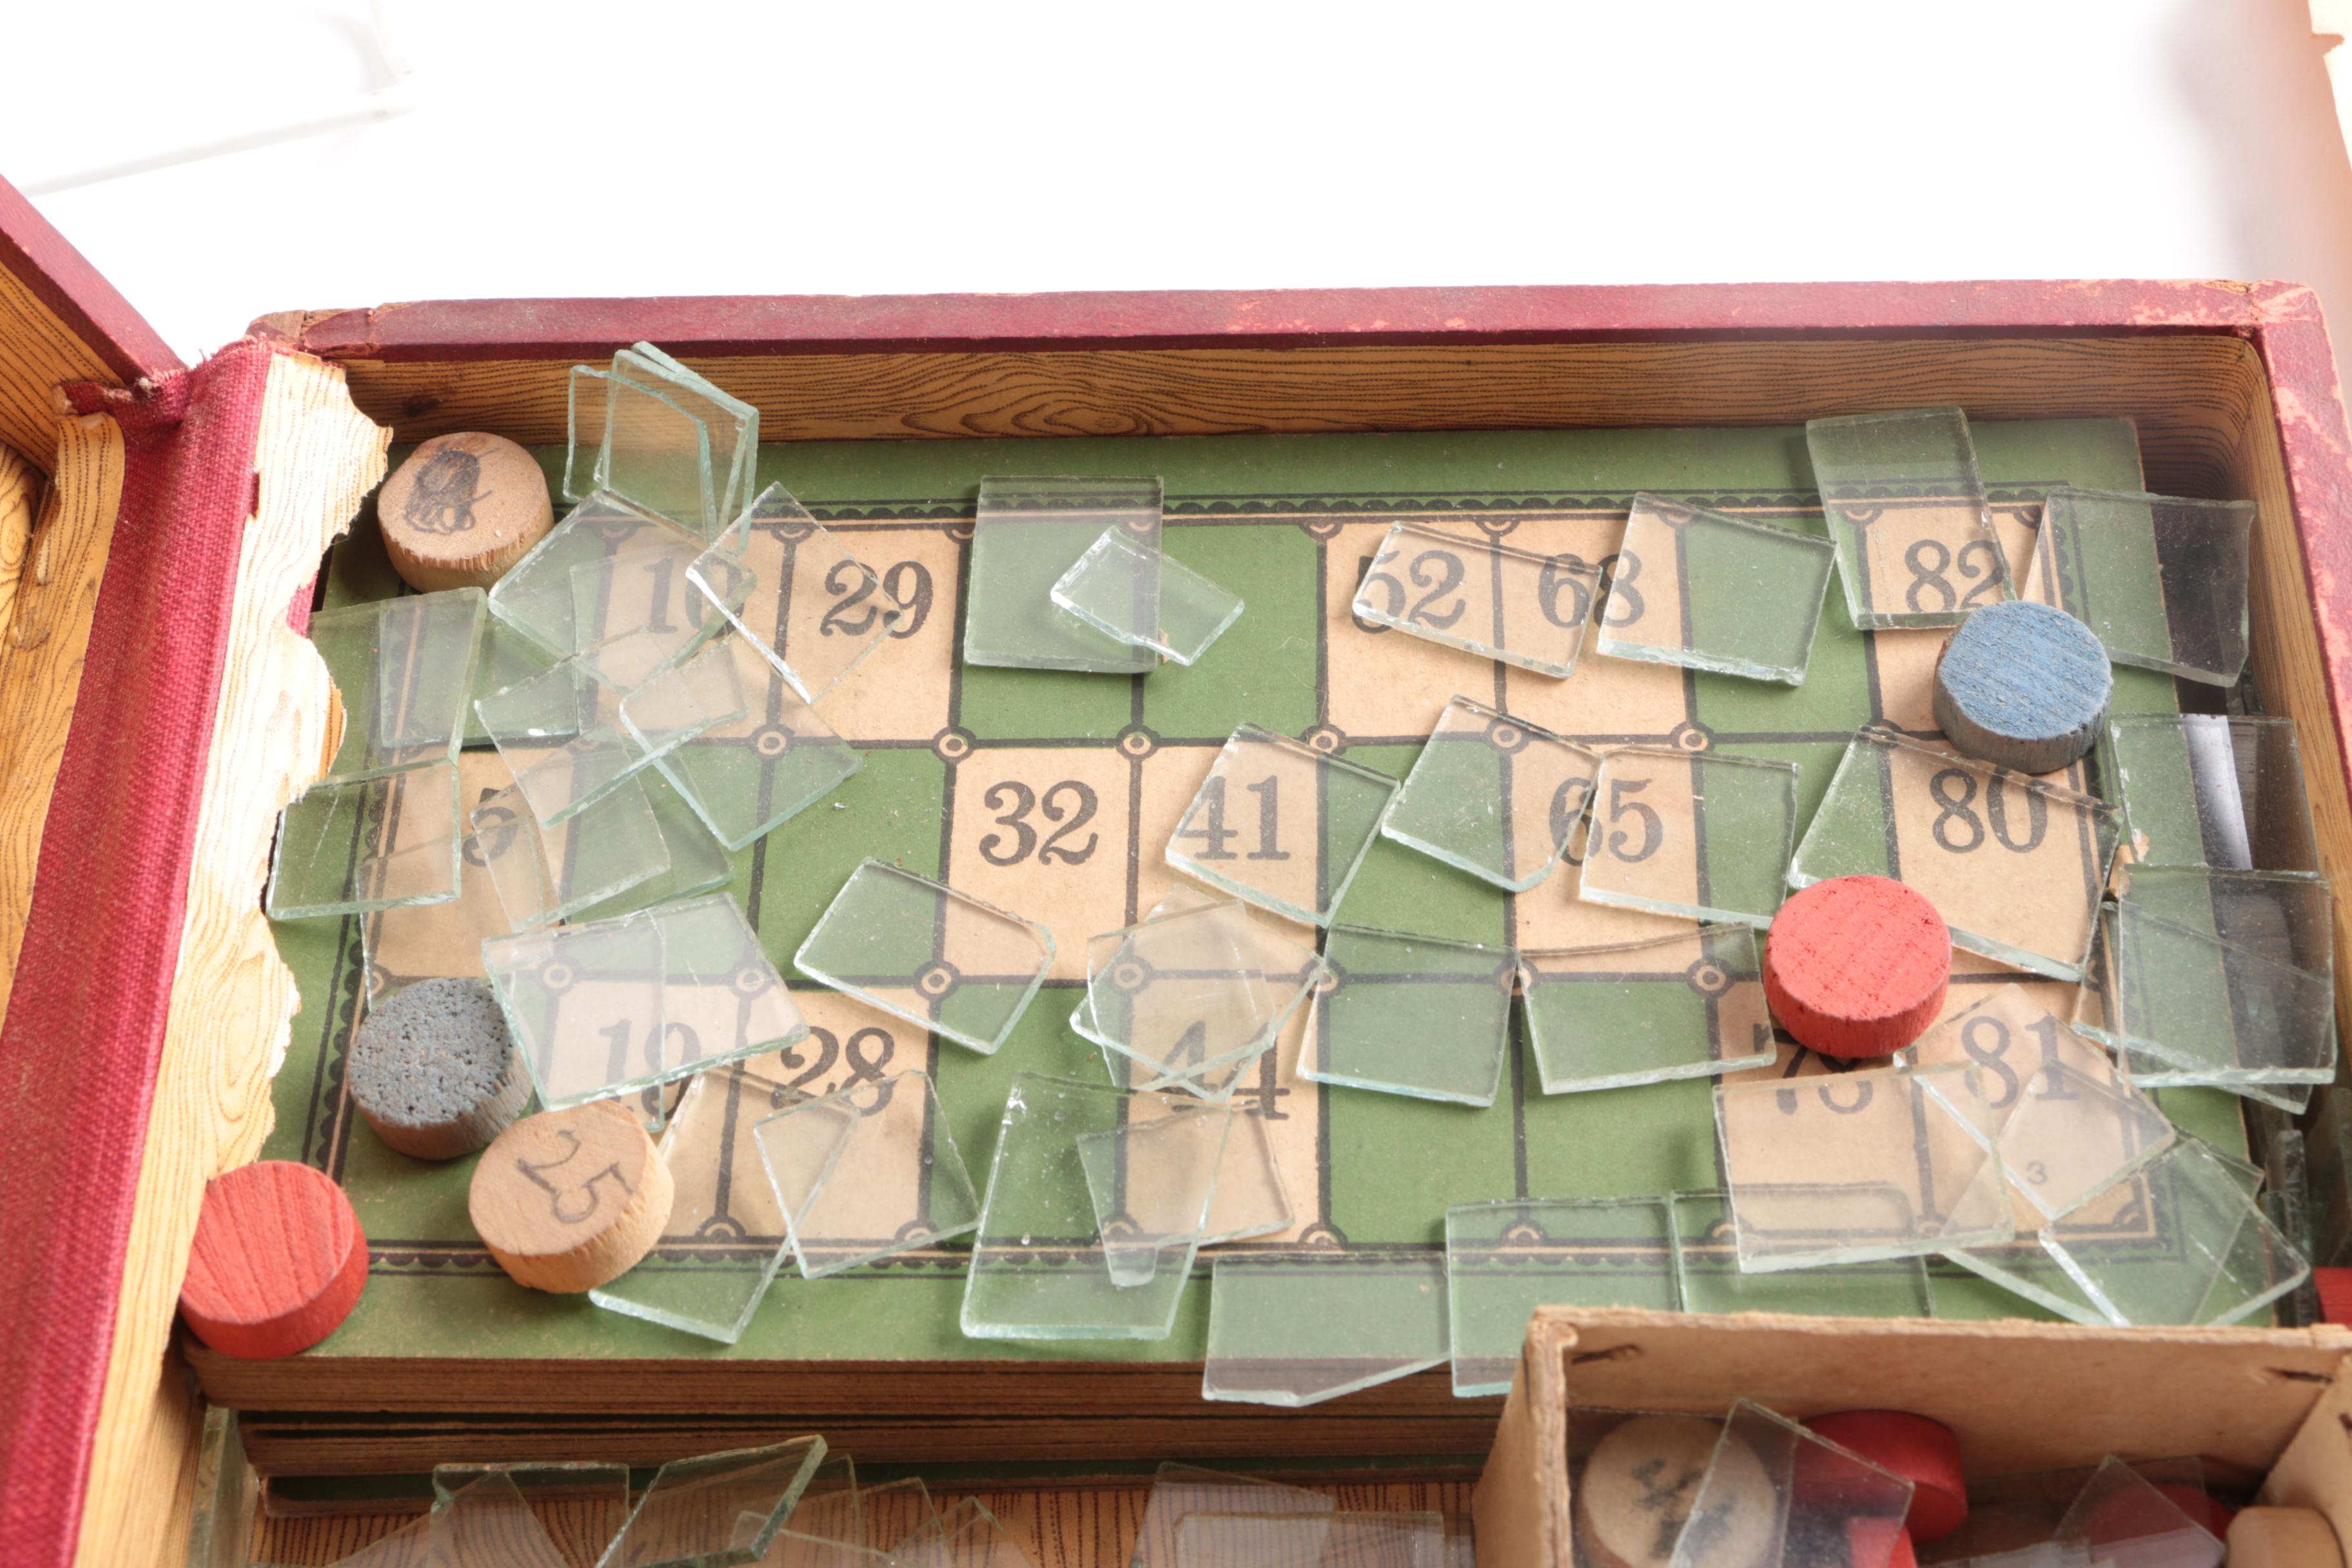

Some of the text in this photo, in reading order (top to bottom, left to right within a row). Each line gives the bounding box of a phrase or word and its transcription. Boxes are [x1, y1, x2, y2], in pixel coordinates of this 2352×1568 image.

[643, 554, 745, 640] 10
[819, 560, 934, 639] 29
[1353, 550, 1467, 634] 52
[1538, 551, 1645, 628] 68
[1904, 539, 2010, 612] 82
[979, 780, 1098, 867] 32
[1175, 774, 1289, 860] 41
[1549, 777, 1663, 866] 65
[1930, 767, 2048, 854] 80
[597, 1018, 701, 1121] 19
[770, 1025, 899, 1117] 28
[1149, 1019, 1291, 1120] 44
[1961, 1015, 2080, 1109] 81
[2026, 1160, 2048, 1185] 3
